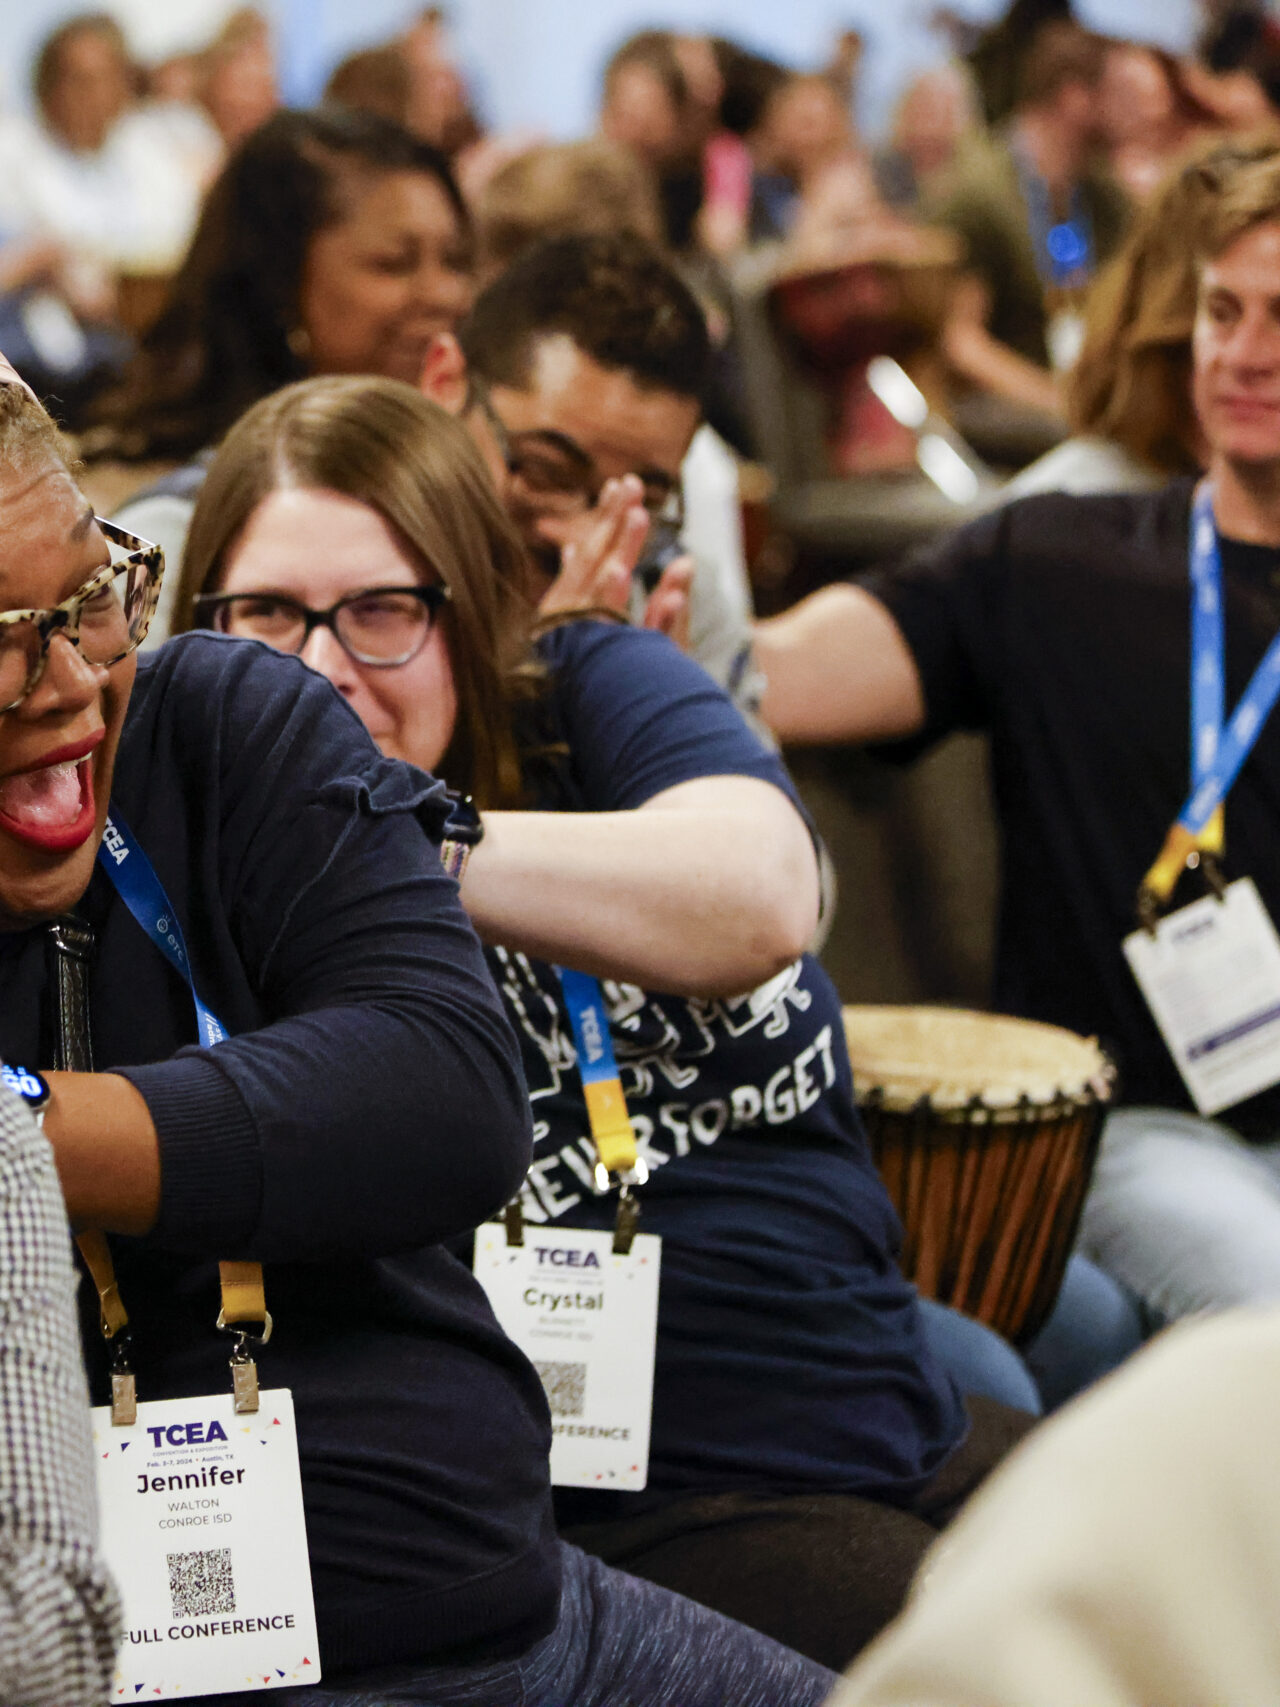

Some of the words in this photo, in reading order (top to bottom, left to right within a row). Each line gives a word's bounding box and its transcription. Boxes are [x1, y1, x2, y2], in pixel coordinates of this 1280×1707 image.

[579, 1004, 605, 1064] TCEA
[500, 1113, 670, 1224] NEVR
[534, 1247, 601, 1269] TCEA
[523, 1287, 604, 1312] Crystal
[147, 1420, 228, 1448] TCEA
[136, 1466, 246, 1494] Jennifer
[168, 1498, 220, 1513] WALTON
[158, 1514, 210, 1530] CONROE
[213, 1513, 233, 1525] ISD
[167, 1614, 296, 1642] CONFERENCE
